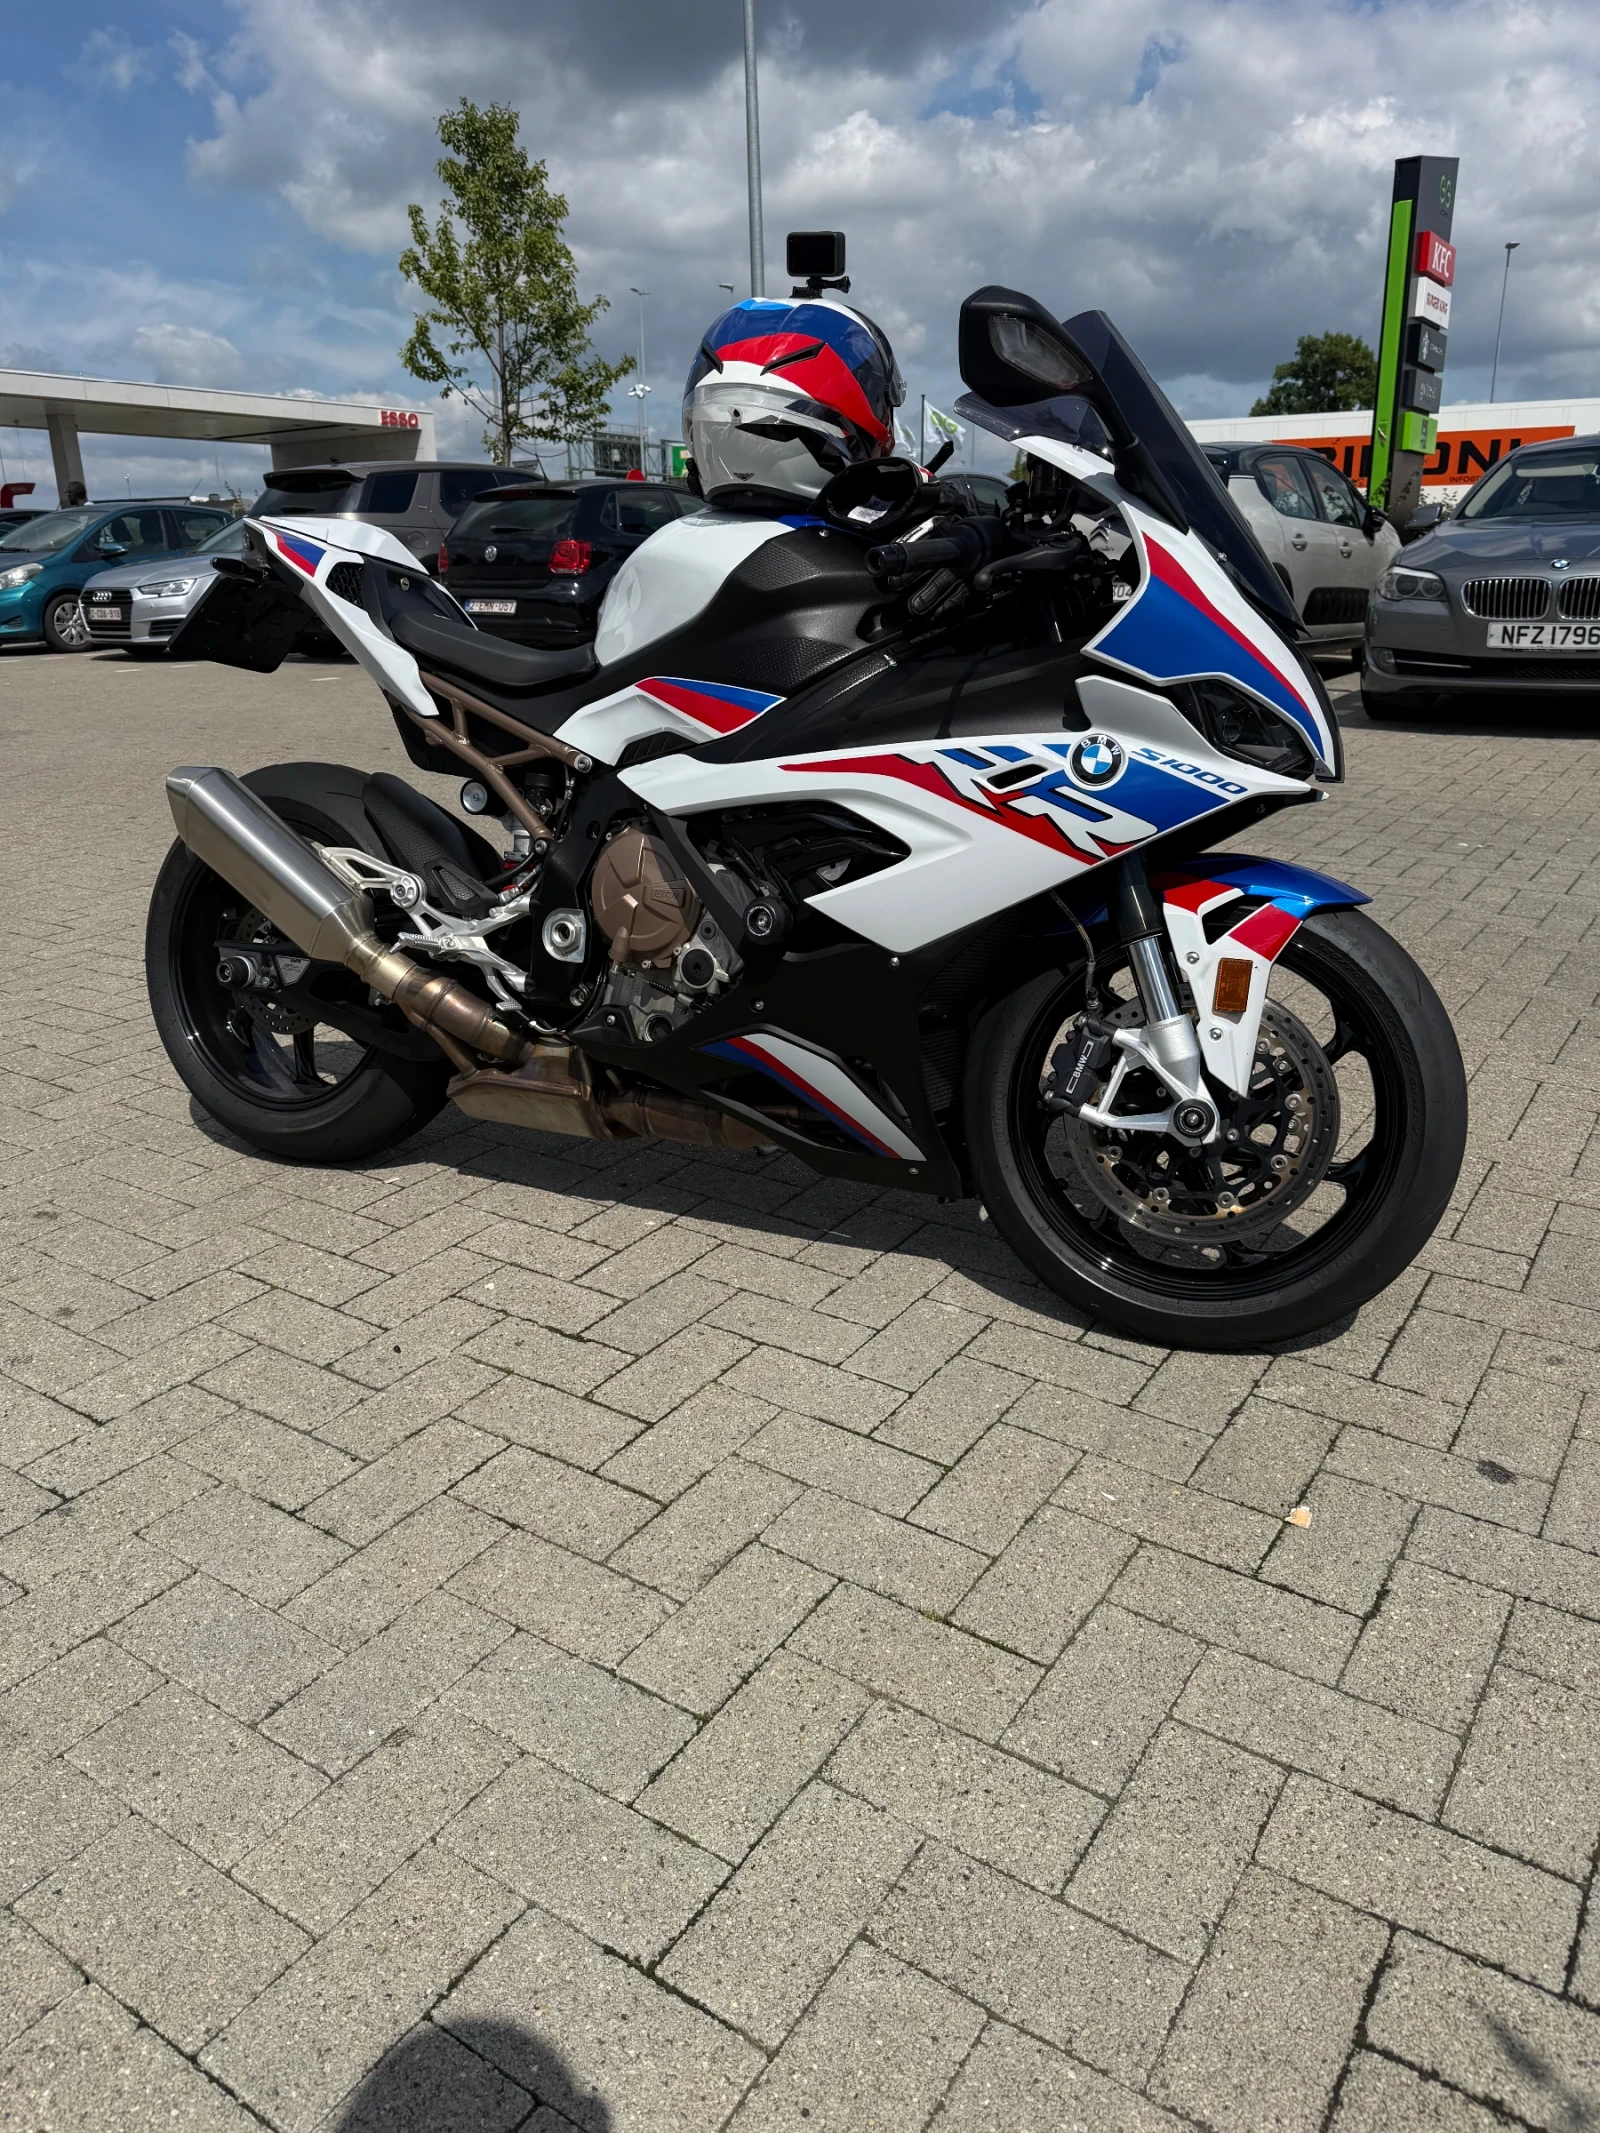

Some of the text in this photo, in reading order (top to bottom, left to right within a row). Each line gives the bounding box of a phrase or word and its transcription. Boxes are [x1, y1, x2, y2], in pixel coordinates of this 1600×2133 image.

[1432, 241, 1452, 278] KFC
[380, 410, 419, 428] ESSO
[1501, 625, 1600, 645] NFZ 1796
[1131, 747, 1249, 795] S1000
[1072, 1054, 1088, 1078] BMW
